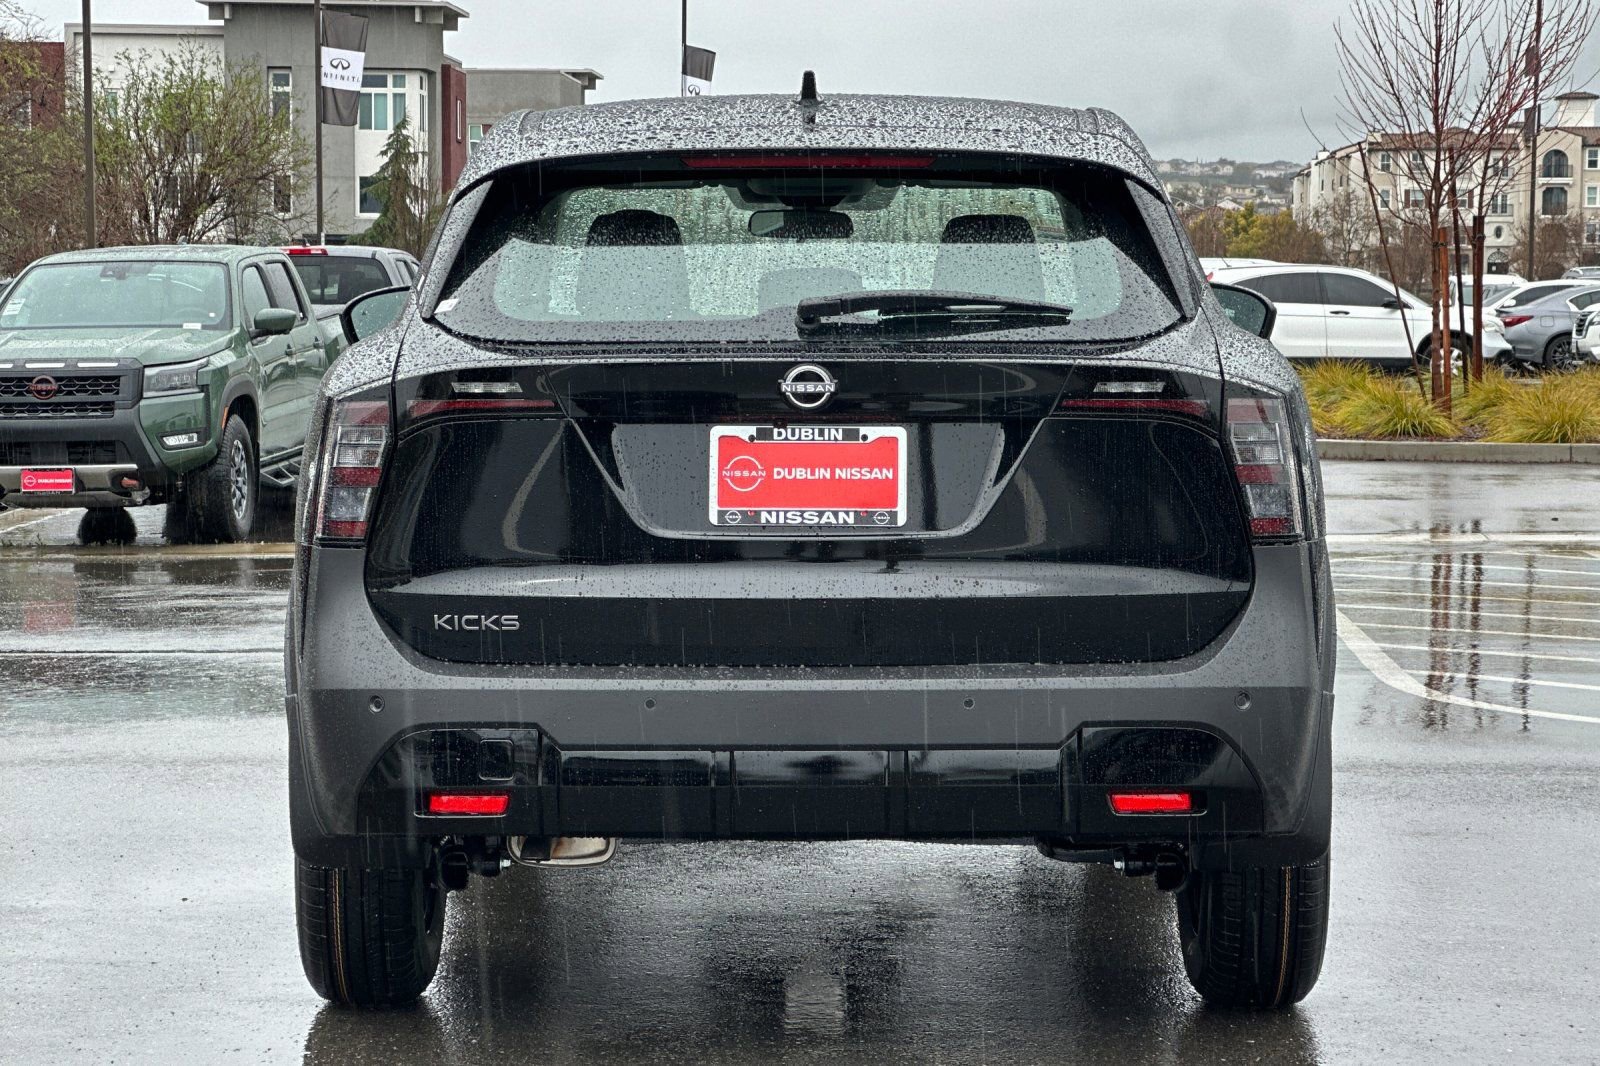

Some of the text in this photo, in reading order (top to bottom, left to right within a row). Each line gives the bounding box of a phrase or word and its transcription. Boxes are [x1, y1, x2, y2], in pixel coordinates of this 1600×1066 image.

[323, 72, 361, 82] NFINITI
[782, 384, 834, 392] NISSAN
[773, 428, 843, 440] DUBLIN
[773, 467, 893, 480] DUBLIN NISSAN
[760, 511, 855, 524] NISSAN
[433, 614, 520, 631] KICKS
